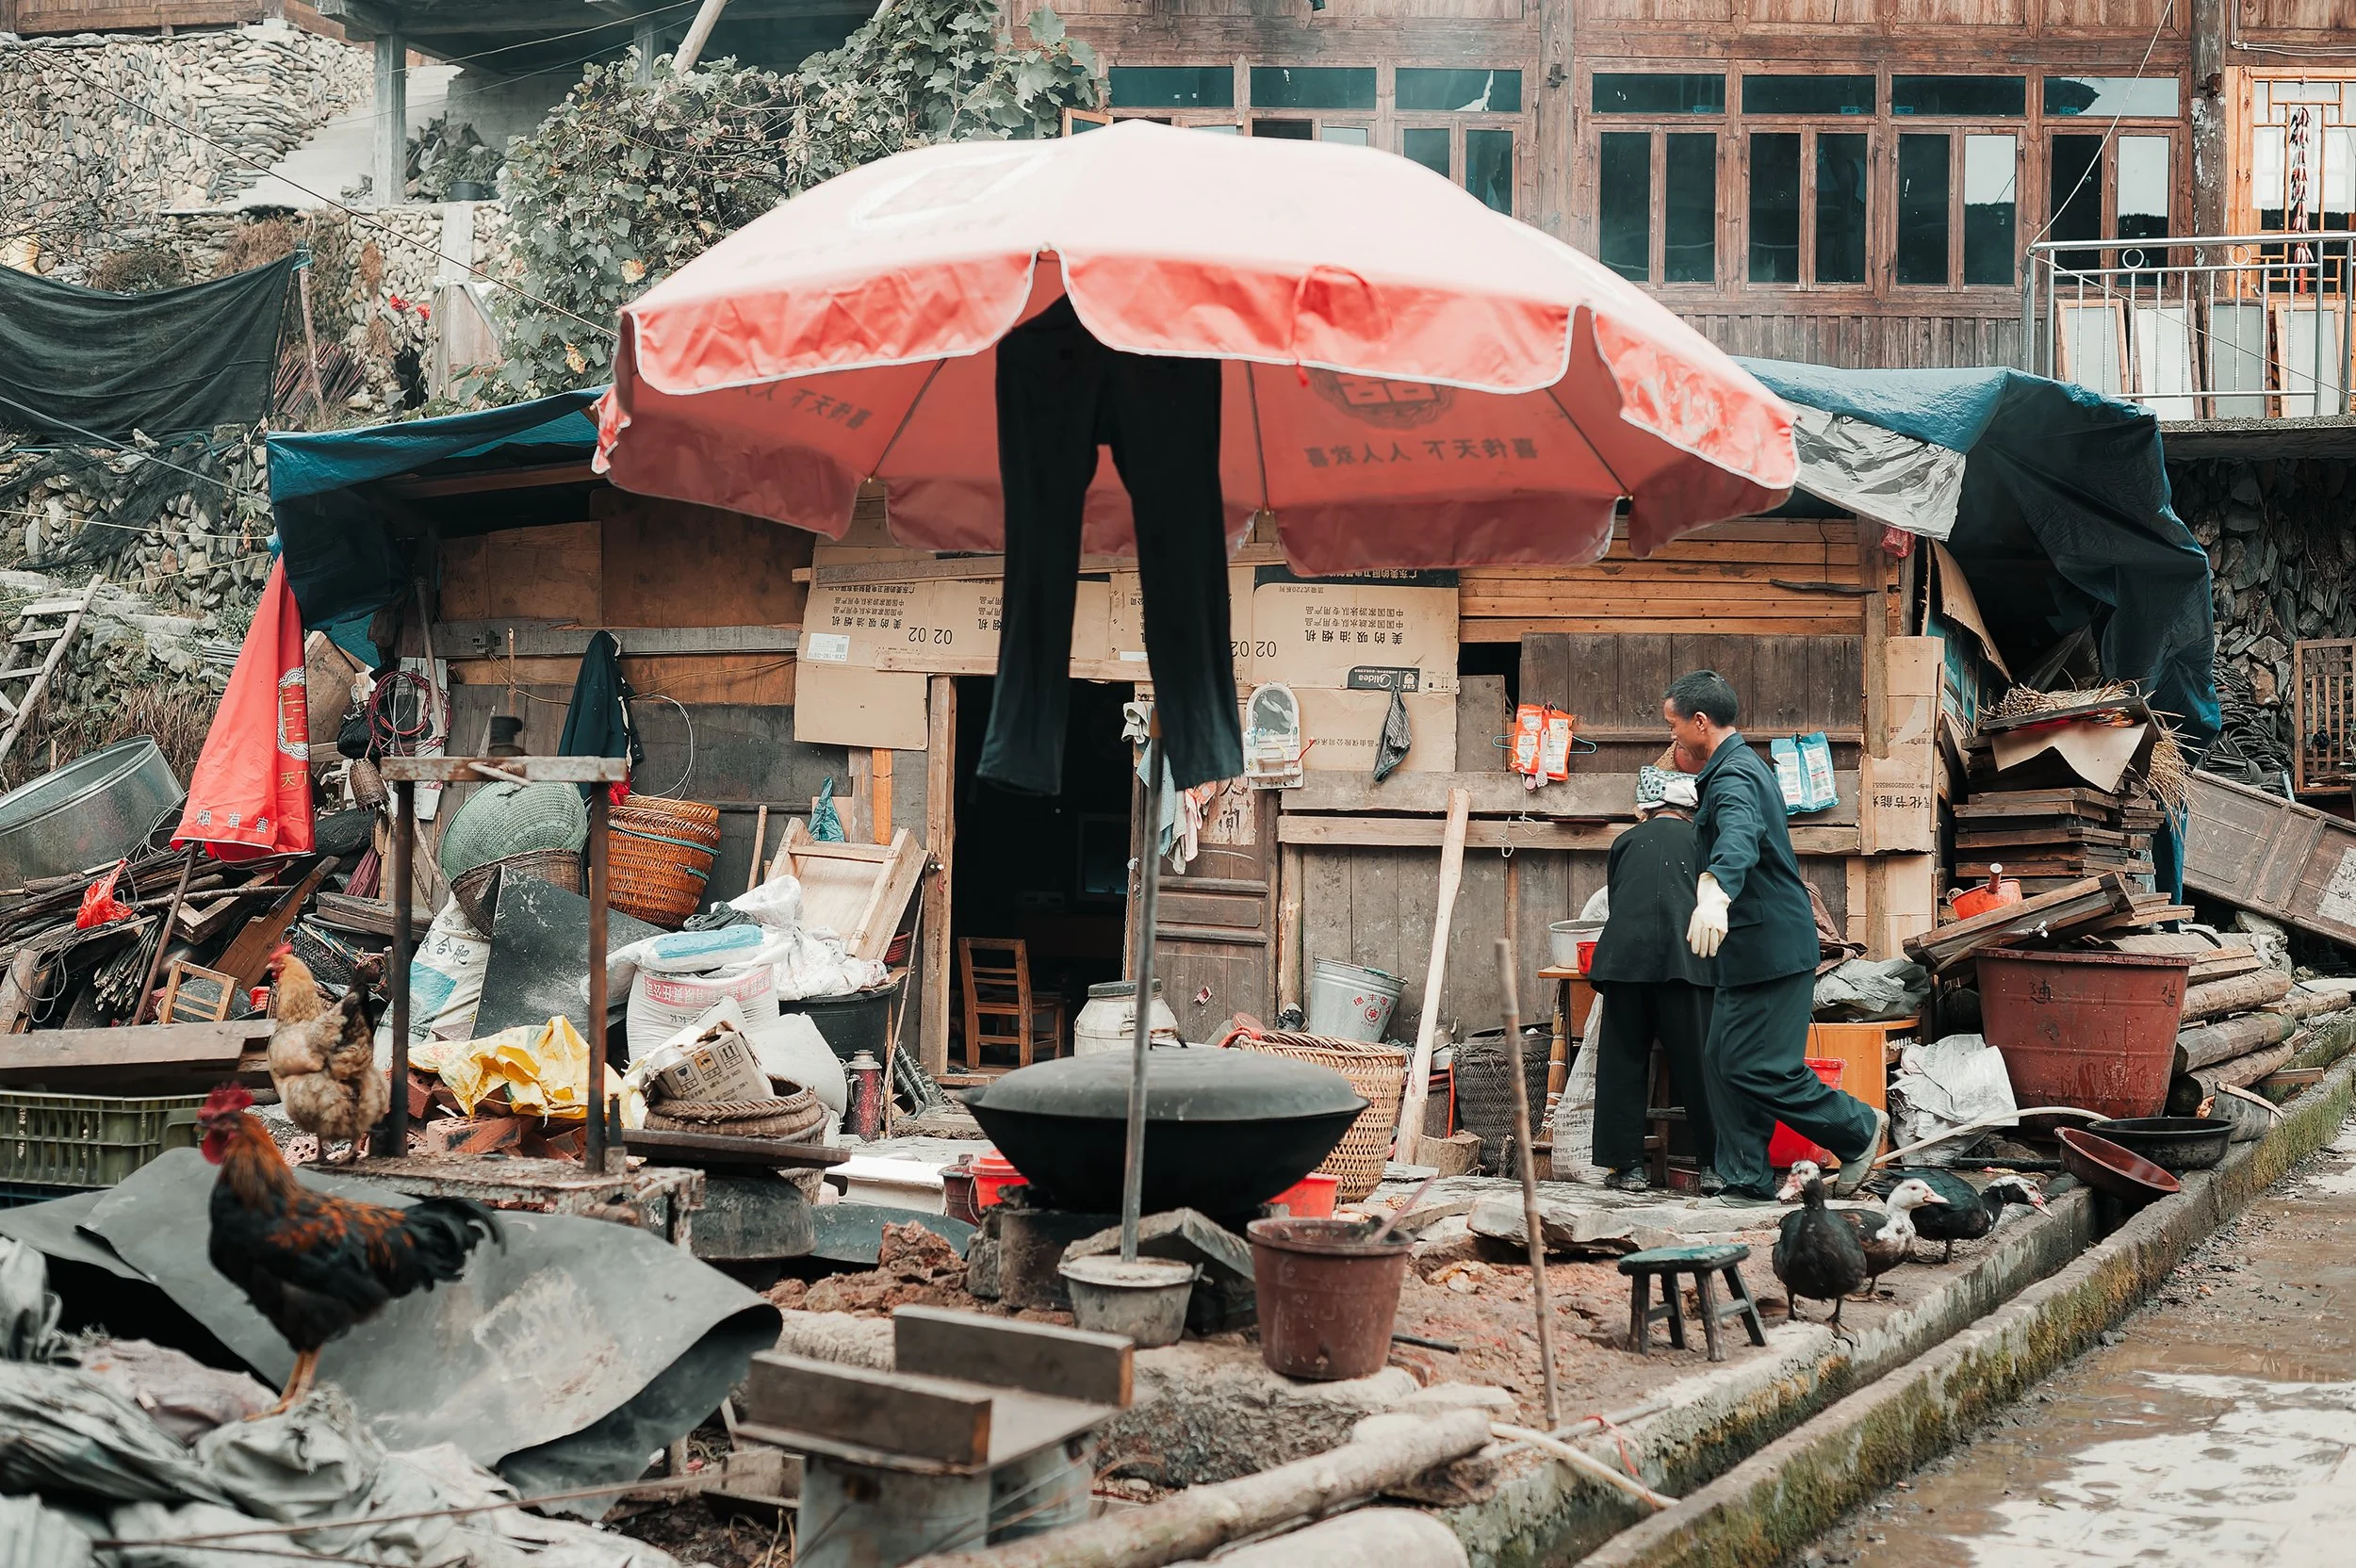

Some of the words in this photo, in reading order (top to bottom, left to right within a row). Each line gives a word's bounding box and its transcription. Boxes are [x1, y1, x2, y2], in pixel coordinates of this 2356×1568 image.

[834, 596, 905, 607] 中国国家游泳队专用产品
[833, 606, 904, 616] 中国国家跳水队专用产品
[1305, 605, 1404, 617] 中国国家游泳队专用产品
[831, 615, 902, 629] 美的吸油烟机
[1304, 617, 1403, 629] 中国国家跳水队专用产品
[908, 627, 926, 643] 02
[934, 629, 953, 645] 02
[1304, 629, 1403, 645] 美的吸油烟机
[1255, 641, 1277, 658] 02
[1358, 674, 1392, 688] Midea
[196, 808, 270, 834] 烟有害
